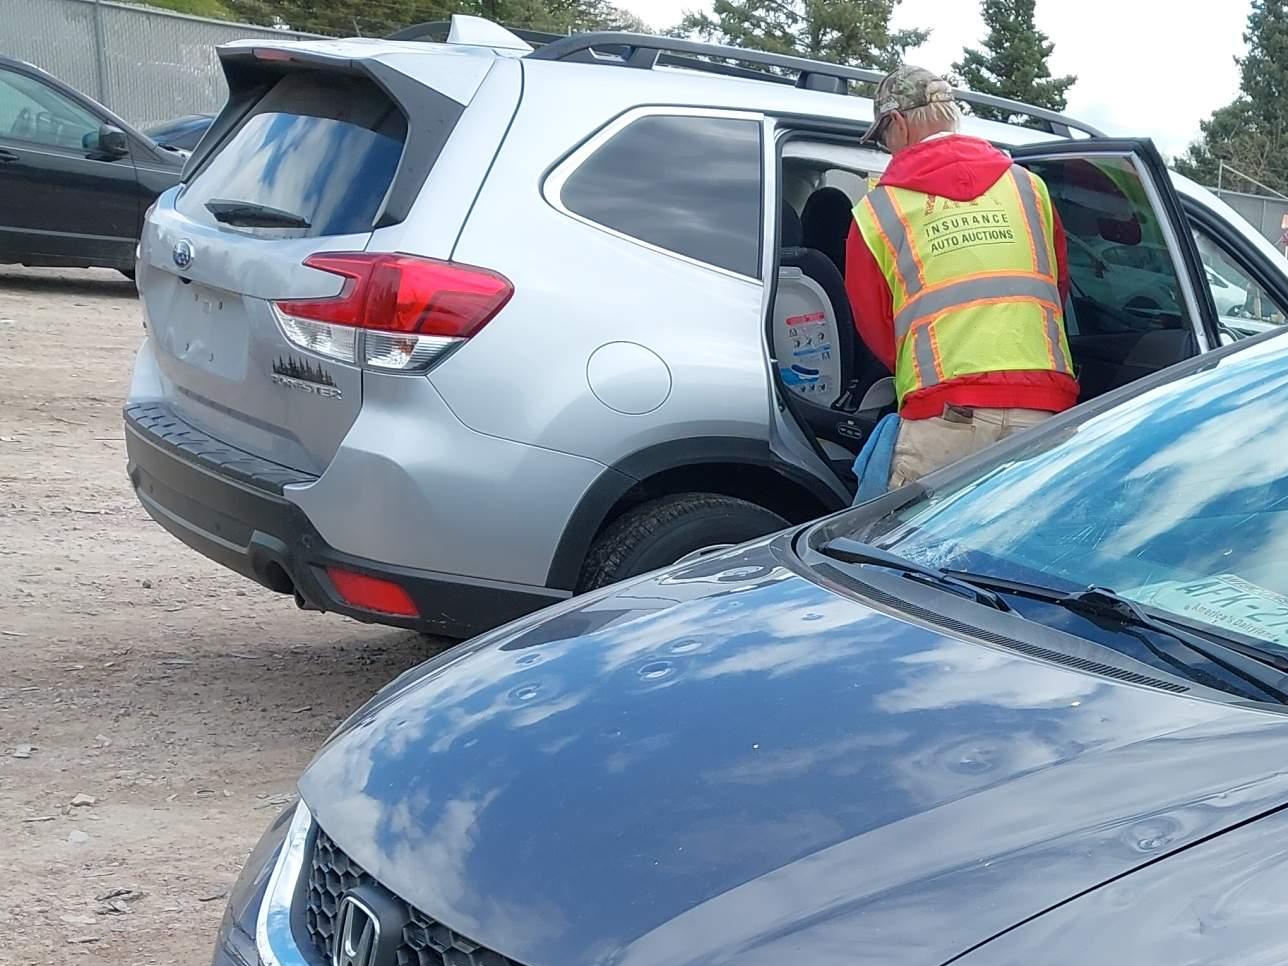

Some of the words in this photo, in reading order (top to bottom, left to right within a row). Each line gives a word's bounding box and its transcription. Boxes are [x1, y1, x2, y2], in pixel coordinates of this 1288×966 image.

[926, 213, 1009, 238] INSURANCE
[931, 235, 960, 253] AUTO
[961, 229, 1014, 245] AUCTIONS
